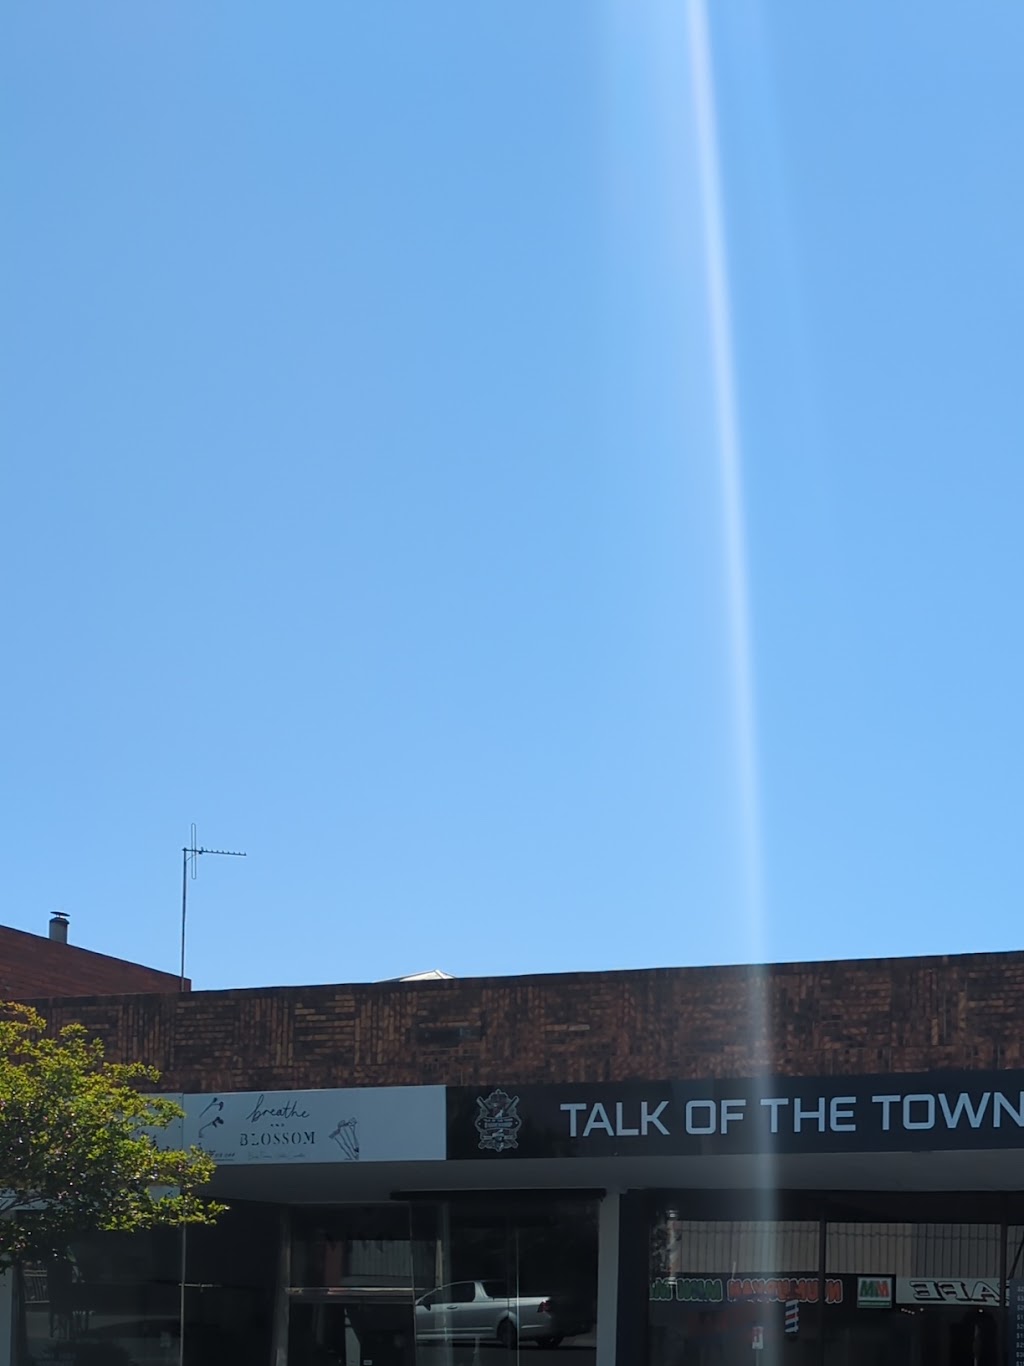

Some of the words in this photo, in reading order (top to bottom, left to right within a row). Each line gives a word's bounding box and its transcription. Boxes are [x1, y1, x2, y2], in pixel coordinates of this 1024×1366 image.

[246, 1094, 311, 1124] breathe
[559, 1100, 671, 1137] TALK
[686, 1099, 747, 1135] OF
[760, 1096, 857, 1133] THE
[239, 1130, 316, 1147] BLOSSOM
